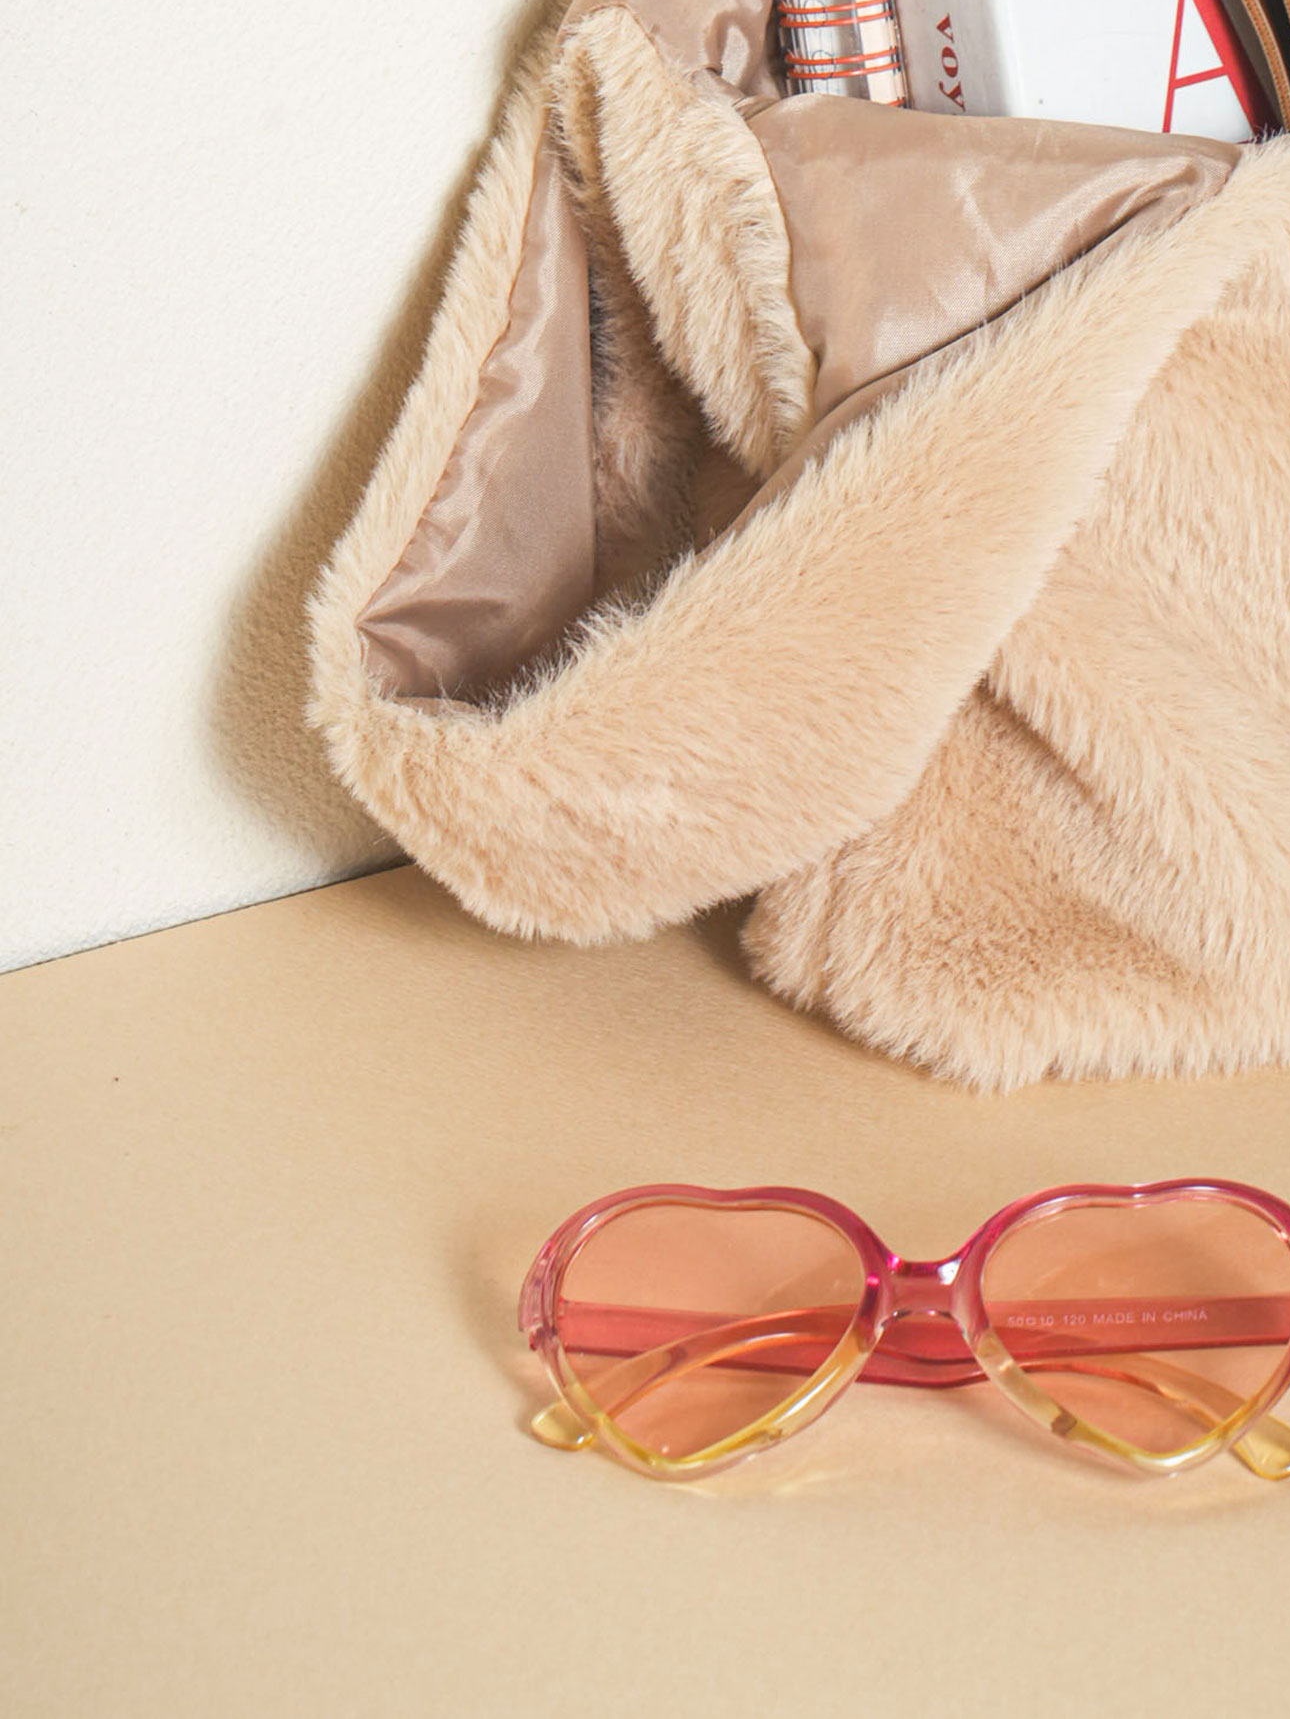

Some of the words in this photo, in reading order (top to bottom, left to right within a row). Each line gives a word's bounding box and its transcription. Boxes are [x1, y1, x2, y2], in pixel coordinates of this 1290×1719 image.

[936, 12, 966, 116] voy
[1064, 1313, 1086, 1325] 120
[1093, 1311, 1133, 1324] MADE
[1142, 1311, 1156, 1323] IN
[1163, 1308, 1208, 1323] CHINA
